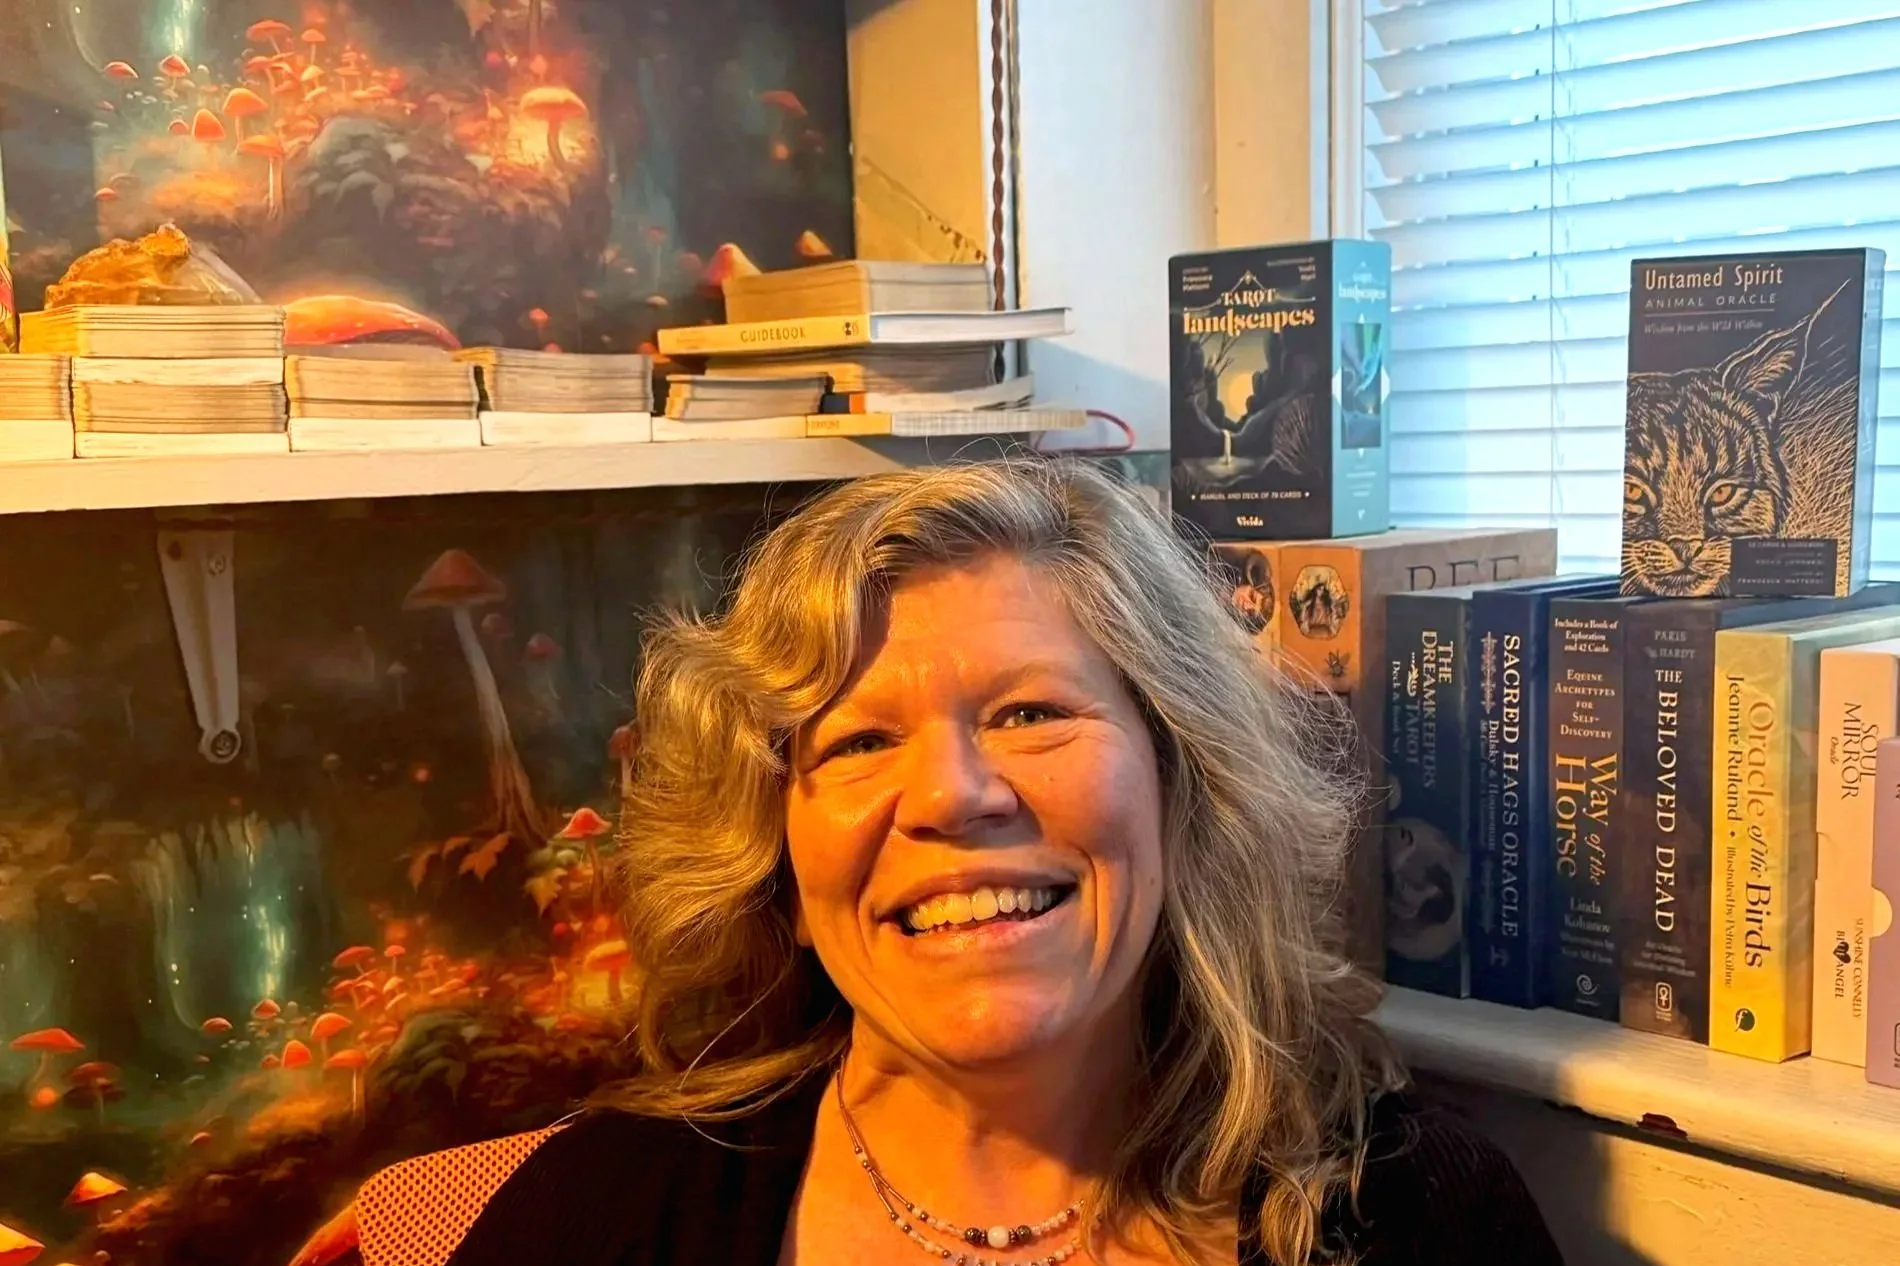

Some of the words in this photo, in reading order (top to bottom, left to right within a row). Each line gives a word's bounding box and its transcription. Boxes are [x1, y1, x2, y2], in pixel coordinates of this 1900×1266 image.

[1222, 288, 1277, 307] TAROT
[1645, 266, 1723, 291] Untamed
[1734, 263, 1783, 292] Spirit
[1183, 308, 1315, 337] landscapes
[1645, 297, 1704, 310] ANIMAL
[1716, 293, 1776, 306] ORACLE
[740, 326, 807, 343] GUIDEBOOK
[1236, 516, 1264, 527] Vivida
[1554, 618, 1583, 629] Includes
[1590, 620, 1608, 629] Book
[1609, 620, 1619, 630] of
[1565, 630, 1606, 643] Exploration
[1438, 640, 1453, 684] THE
[1564, 643, 1578, 652] and
[1503, 634, 1521, 744] SACRED
[1655, 669, 1684, 684] THE
[1405, 700, 1420, 765] TAROT
[1421, 630, 1437, 791] DREAMKEEPERS
[1726, 675, 1744, 746] Jeanne
[1488, 719, 1500, 764] Dulsky
[1656, 691, 1678, 832] BELOVED
[1746, 702, 1774, 817] Oracle
[1841, 701, 1862, 800] MIRROR
[1859, 724, 1879, 783] SOUL
[1502, 751, 1520, 826] HAGS
[1582, 752, 1617, 826] Way
[1727, 751, 1743, 821] Ruland
[1555, 752, 1586, 878] Horse
[1747, 824, 1768, 847] of
[1584, 832, 1606, 858] of
[1750, 847, 1768, 878] the
[1501, 832, 1519, 937] ORACLE
[1589, 855, 1606, 886] the
[1655, 845, 1676, 932] DEAD
[1725, 846, 1736, 902] Illustrated
[1570, 896, 1602, 914] Linda
[1745, 881, 1772, 968] Birds
